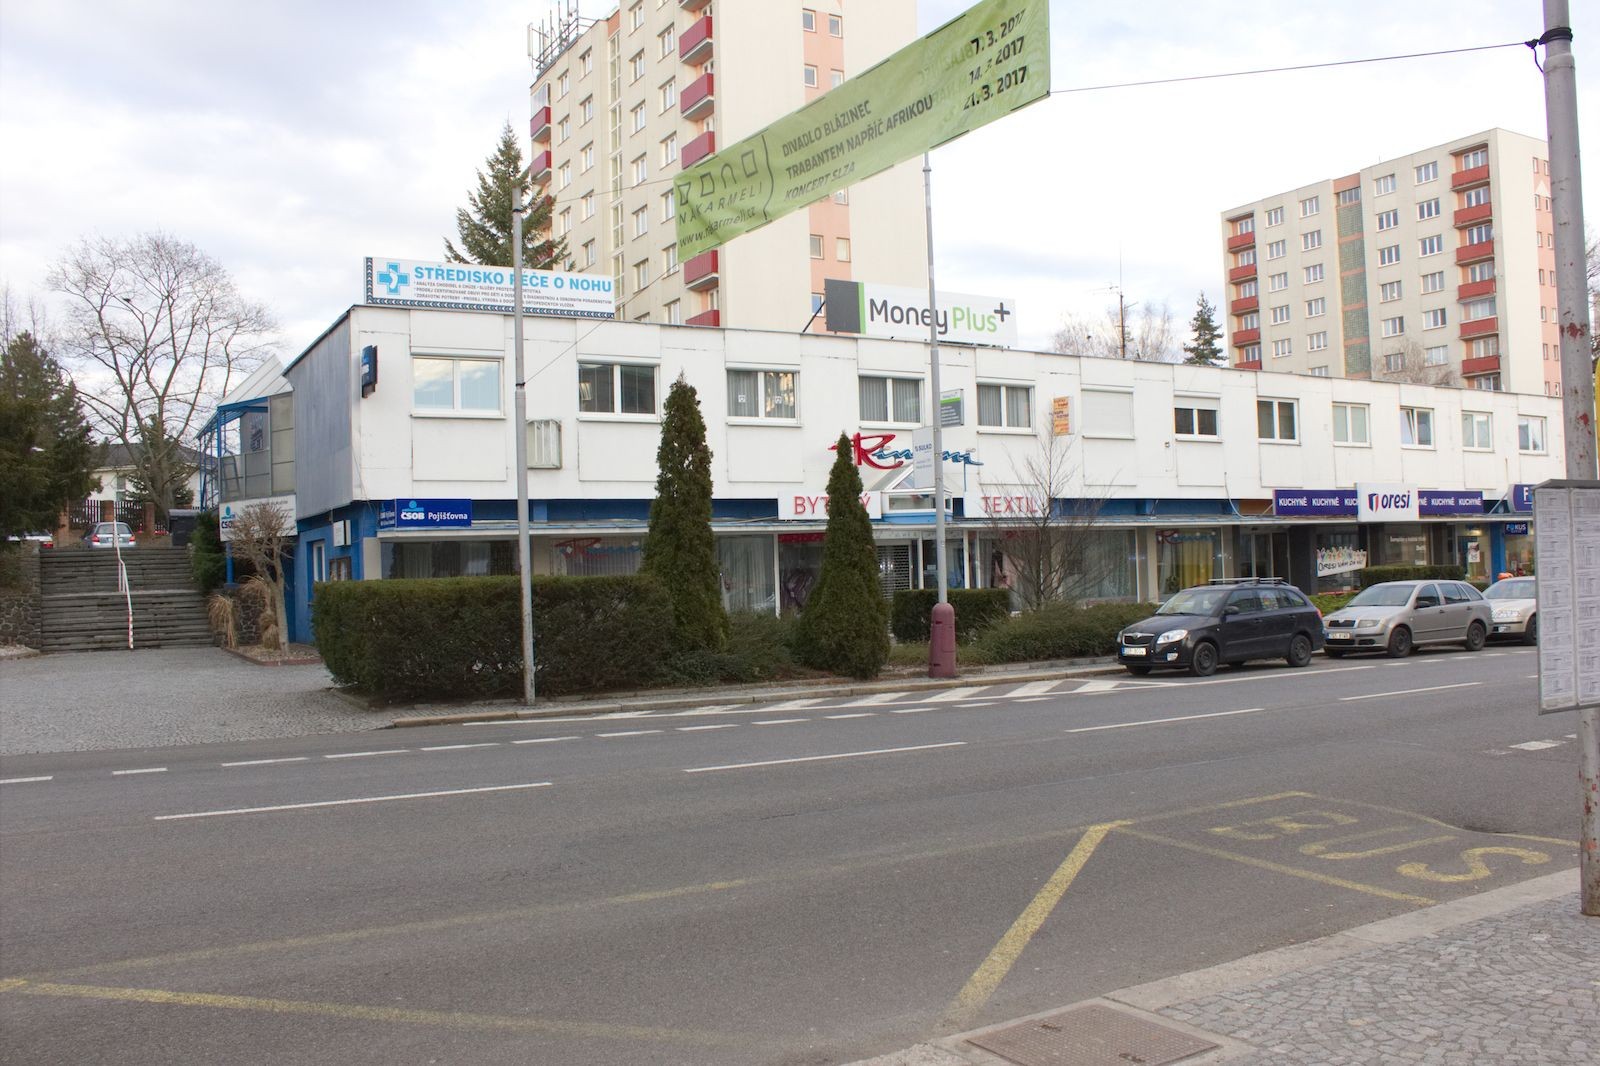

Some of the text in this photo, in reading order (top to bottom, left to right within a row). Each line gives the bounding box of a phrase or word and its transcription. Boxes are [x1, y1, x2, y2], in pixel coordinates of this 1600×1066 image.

[970, 38, 985, 55] 7.
[986, 30, 998, 47] 3.
[995, 36, 1025, 65] 2017
[982, 85, 994, 101] 3.
[997, 66, 1027, 94] 2017
[782, 99, 872, 157] DIVADLO BLÁZINEC
[785, 94, 933, 180] TRABANTEM NAPŘÍČ AFRIKOU
[784, 161, 856, 201] KONCERT SLZA
[414, 265, 504, 285] STŘEDISKO
[554, 277, 564, 288] O
[569, 278, 612, 292] NOHU
[794, 493, 871, 515] BYTÝ
[981, 496, 1038, 513] TEXTIL
[1381, 489, 1411, 509] oresi
[400, 511, 425, 520] ČSOB
[427, 511, 468, 522] Pojišťovna
[1506, 523, 1527, 531] FOKUS
